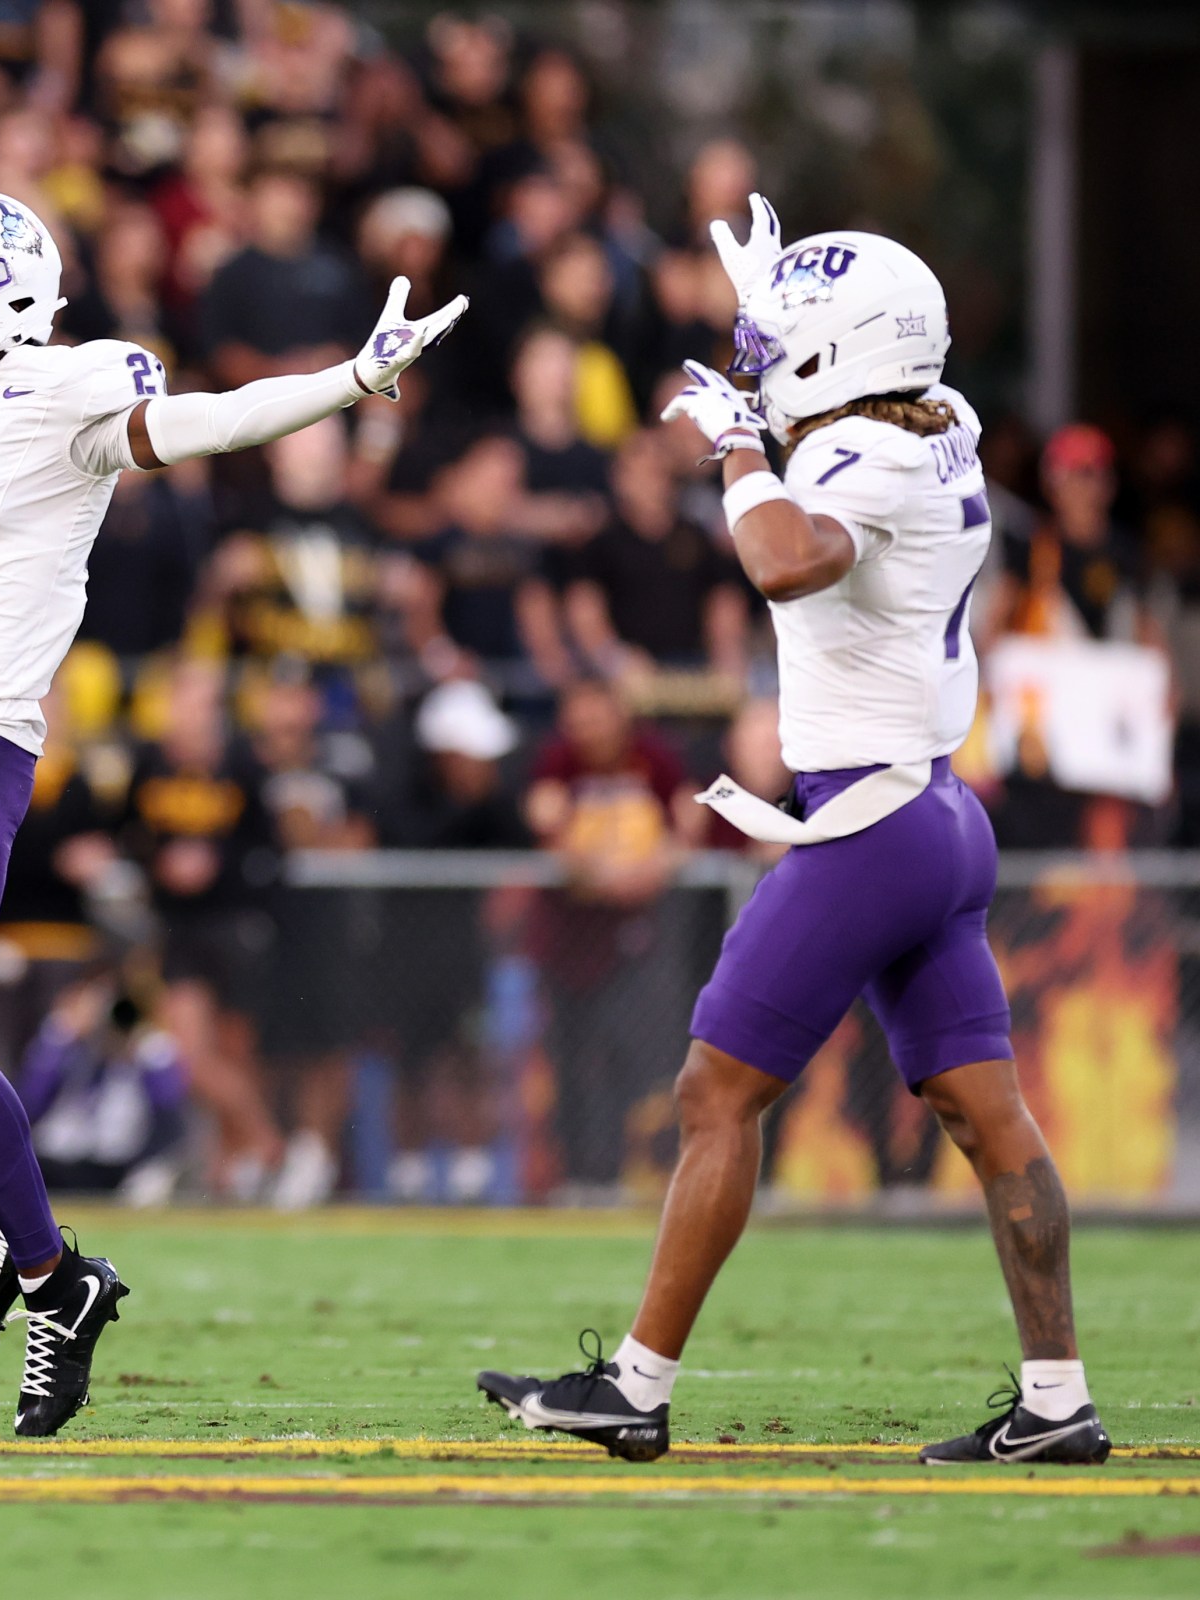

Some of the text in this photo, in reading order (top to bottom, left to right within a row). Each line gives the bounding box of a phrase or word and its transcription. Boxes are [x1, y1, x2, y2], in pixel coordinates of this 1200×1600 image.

[770, 246, 857, 289] TCU
[816, 447, 861, 485] 7
[942, 486, 992, 660] 7
